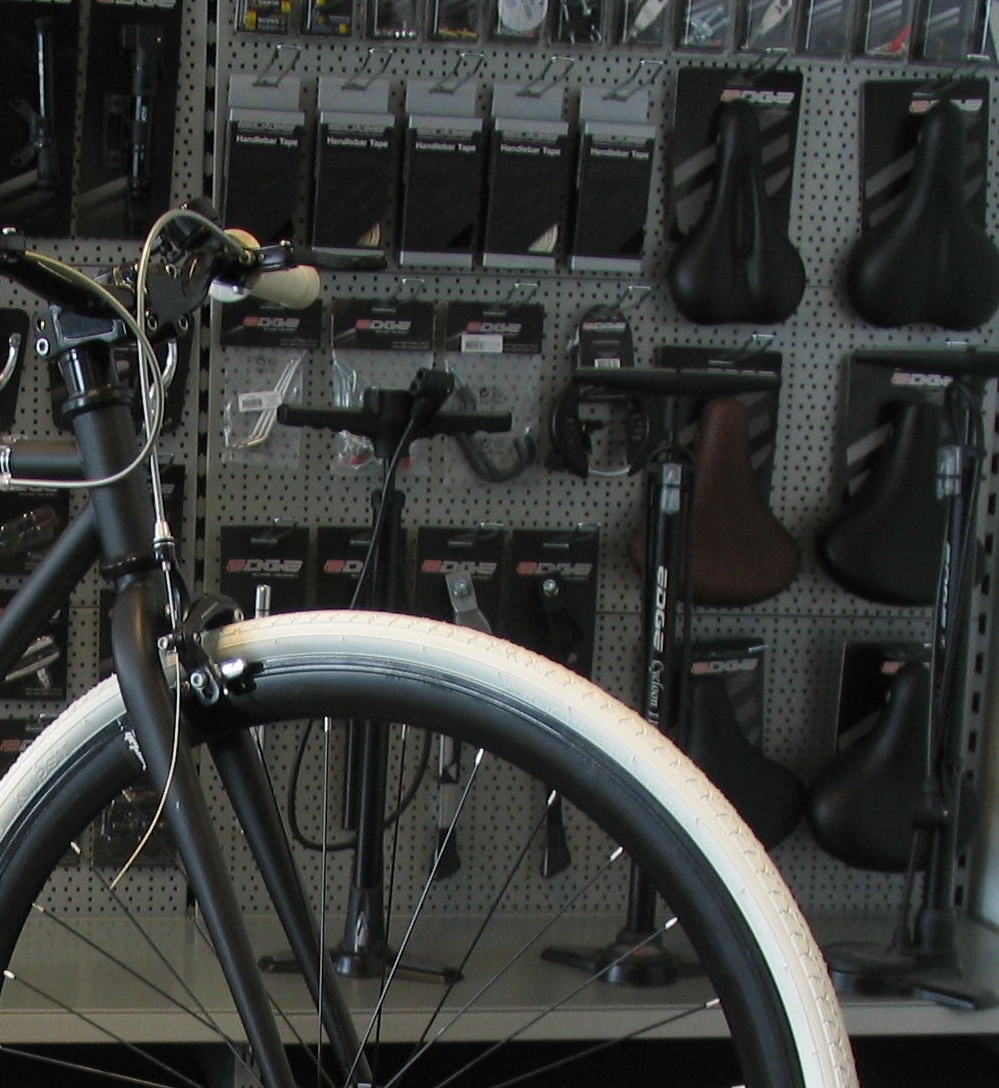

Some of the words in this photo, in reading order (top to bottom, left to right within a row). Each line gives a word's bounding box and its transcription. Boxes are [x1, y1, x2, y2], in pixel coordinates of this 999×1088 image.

[236, 135, 277, 145] Handlebar
[279, 137, 298, 147] Tape
[327, 137, 368, 146] Handlebar
[370, 138, 388, 148] Tape
[226, 559, 303, 573] EDGE
[653, 565, 669, 653] EDGE
